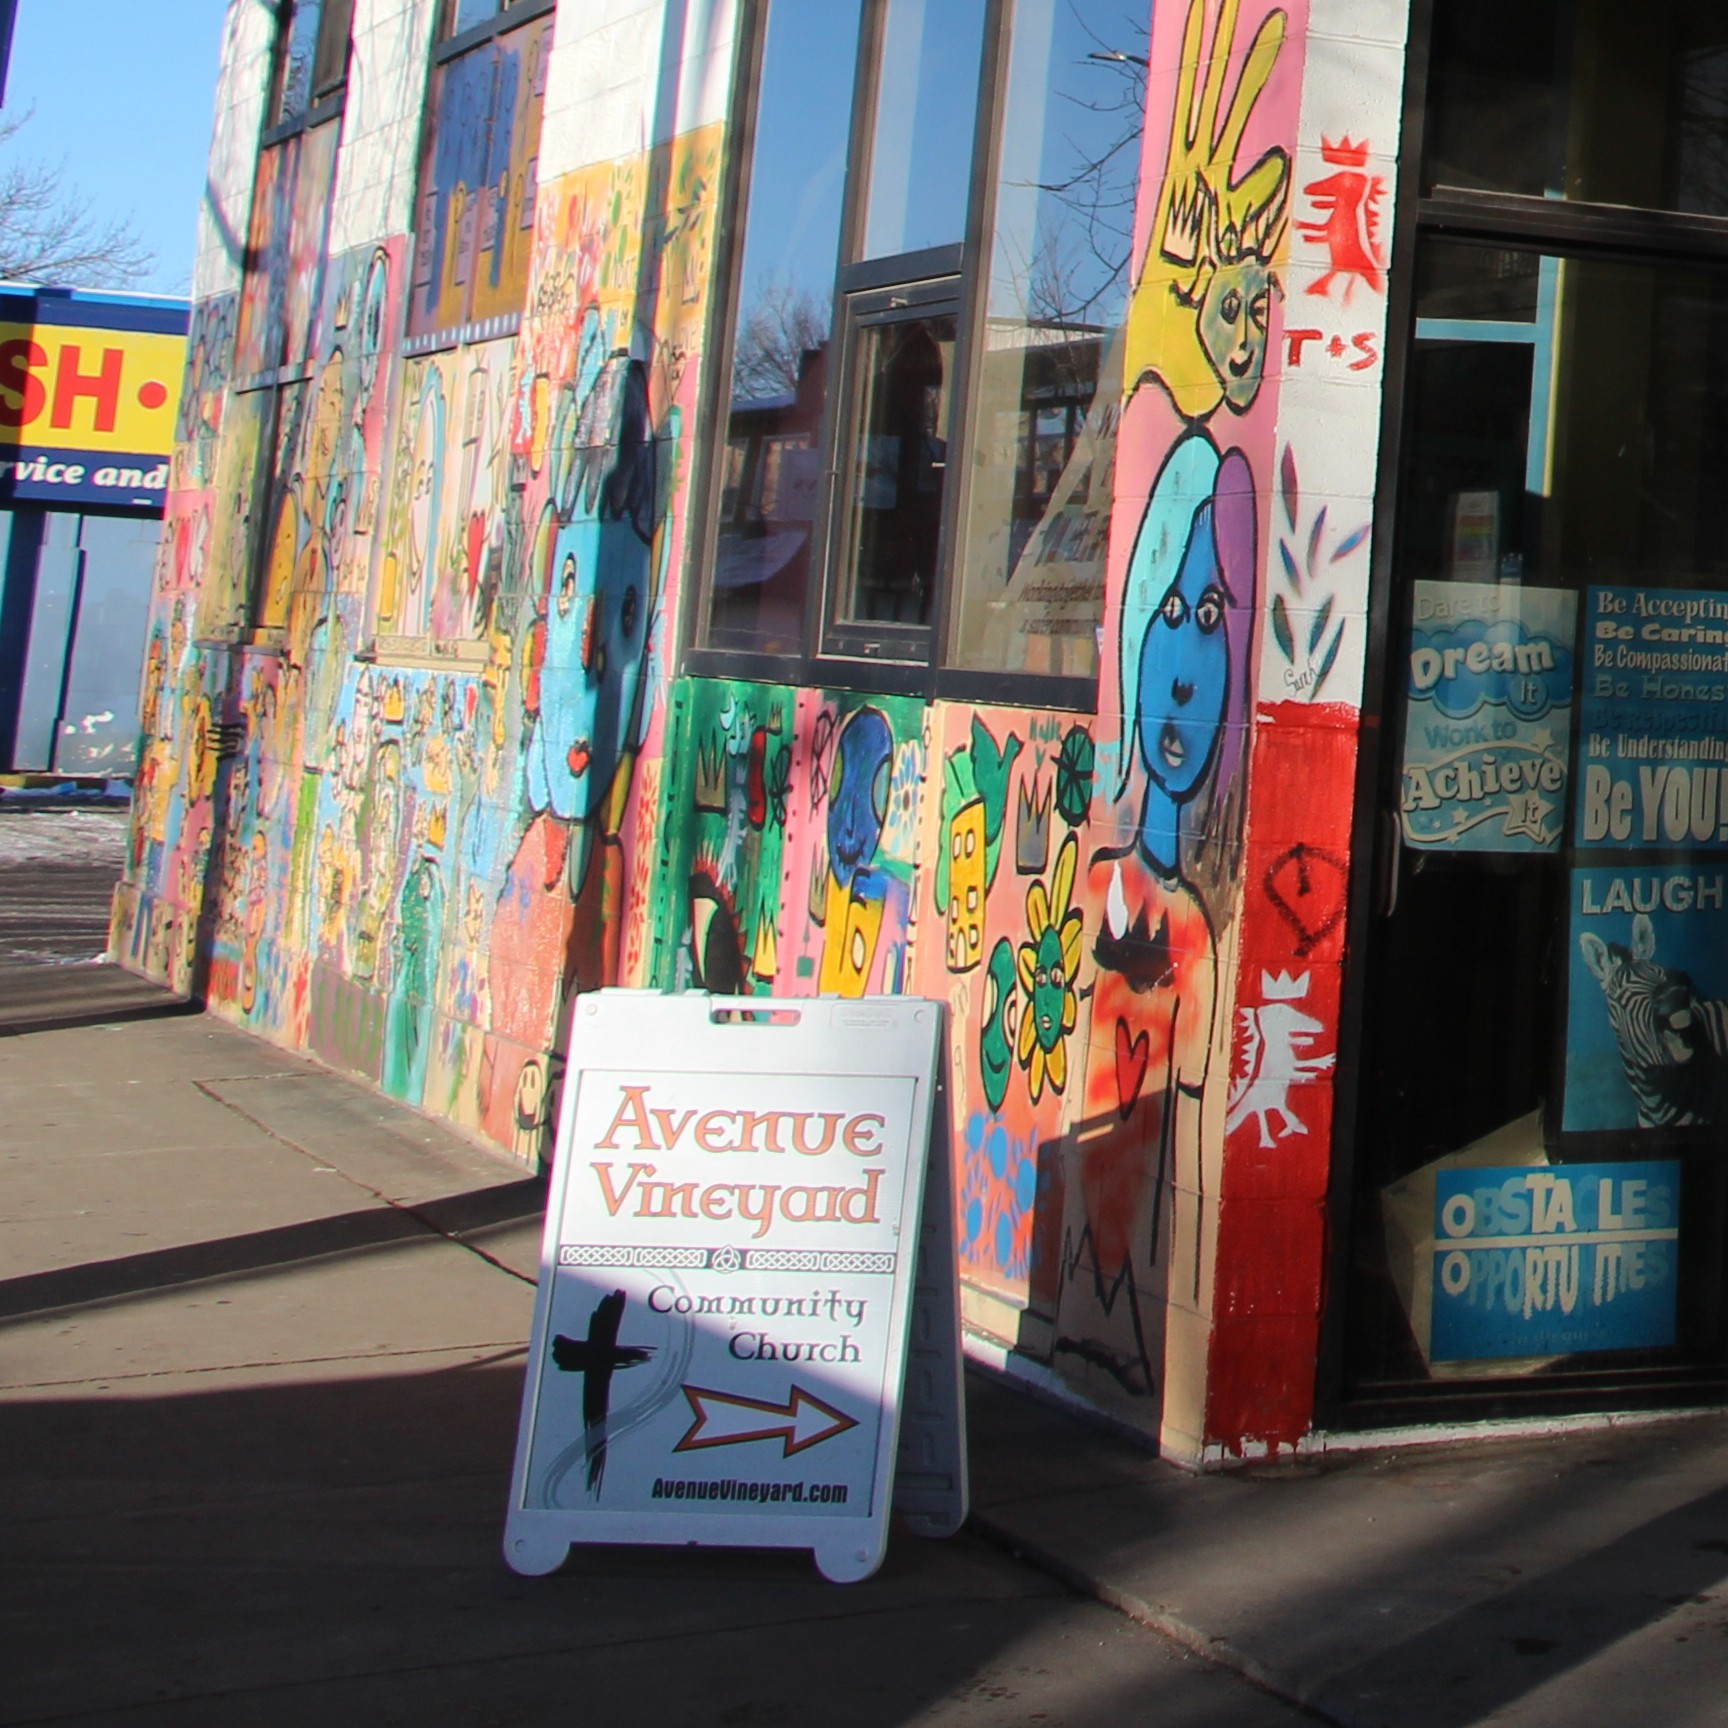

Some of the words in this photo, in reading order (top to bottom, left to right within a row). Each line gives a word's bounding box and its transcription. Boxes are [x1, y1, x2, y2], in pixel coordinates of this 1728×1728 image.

[93, 464, 169, 489] and
[1416, 597, 1473, 621] Dare
[1479, 593, 1502, 614] to
[1596, 592, 1628, 615] Be
[1594, 621, 1634, 641] Be
[1410, 641, 1556, 691] Dream
[1593, 644, 1614, 667] Be
[1520, 681, 1539, 705] It
[1593, 674, 1630, 698] Be
[1592, 708, 1624, 730] Be
[1424, 722, 1485, 750] Work
[1493, 720, 1518, 742] to
[1588, 734, 1612, 758] Be
[1402, 754, 1564, 812] Achieve
[1520, 800, 1540, 823] It
[1583, 765, 1634, 843] Be
[1581, 872, 1724, 919] LAUGH
[593, 1086, 887, 1158] Avenue
[589, 1161, 887, 1239] Vineyard
[1441, 1172, 1672, 1238] OBSTACLES
[647, 1284, 869, 1328] Community
[728, 1331, 863, 1363] Church
[651, 1478, 848, 1505] AvenueVineyard.com
